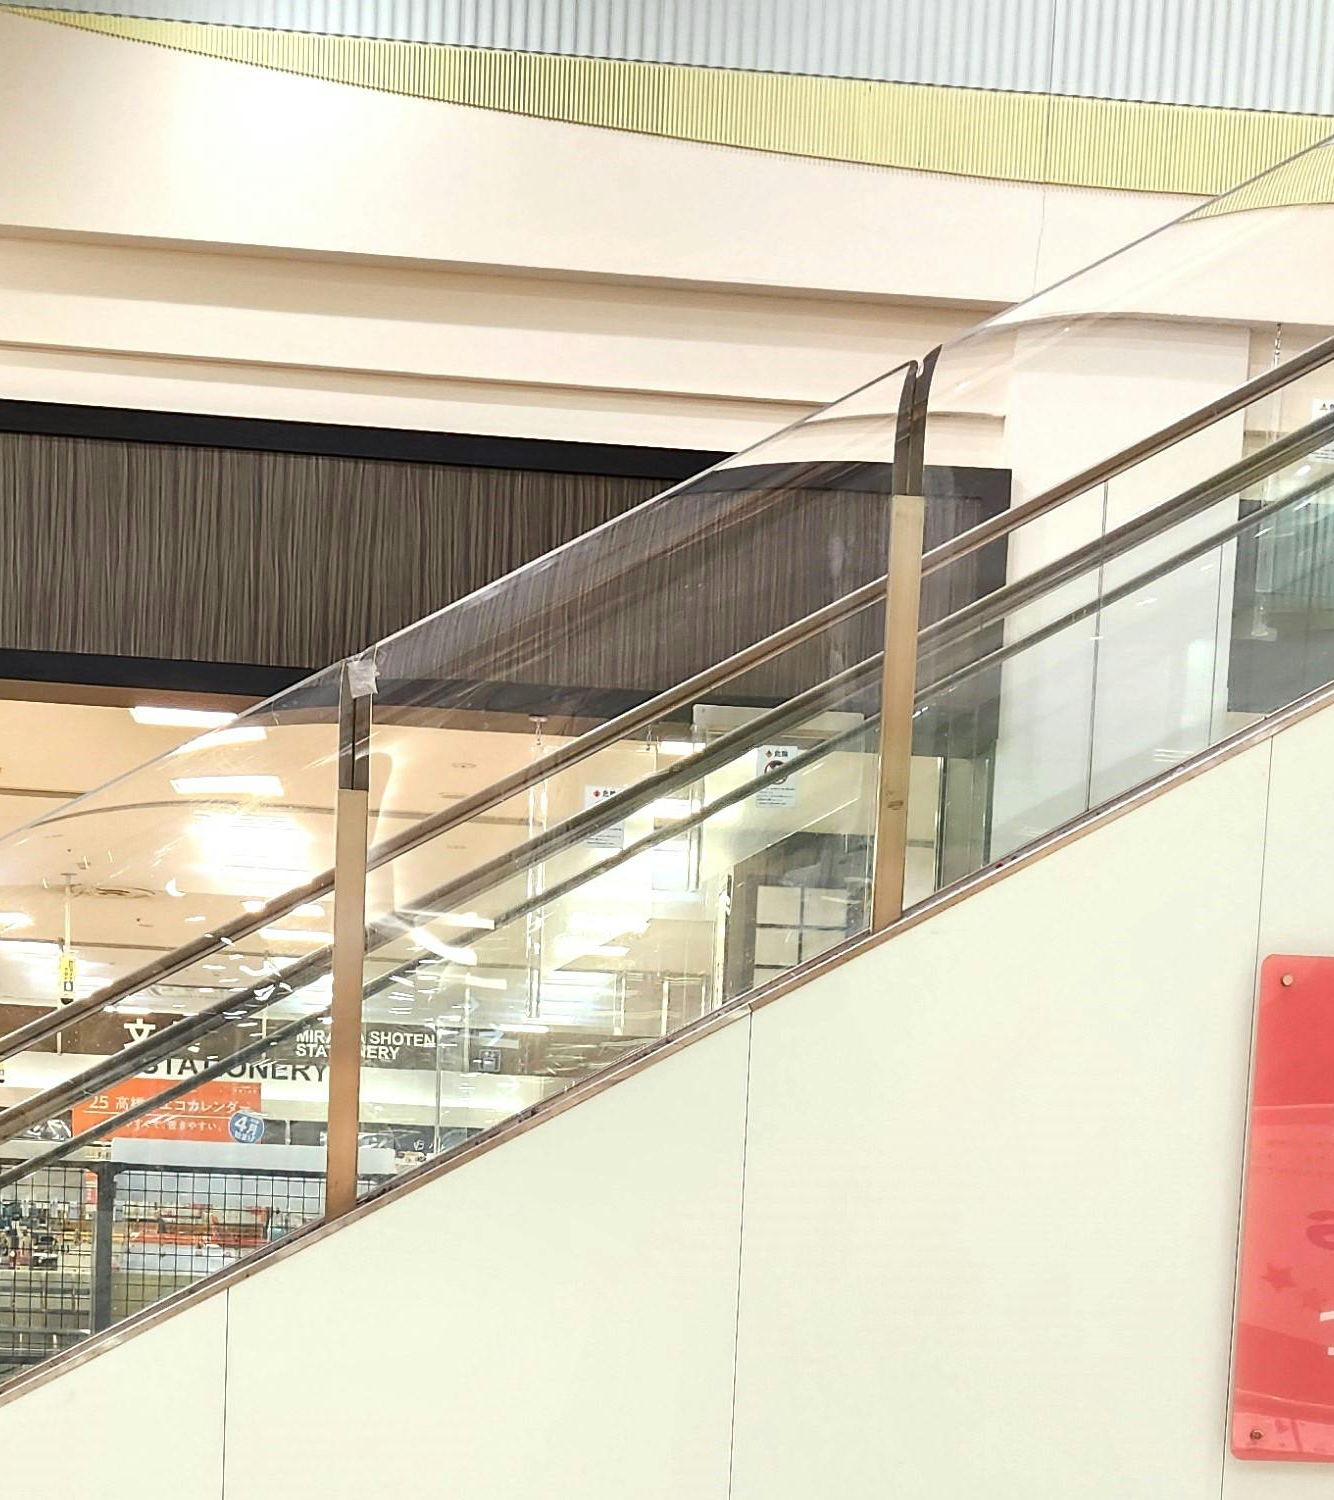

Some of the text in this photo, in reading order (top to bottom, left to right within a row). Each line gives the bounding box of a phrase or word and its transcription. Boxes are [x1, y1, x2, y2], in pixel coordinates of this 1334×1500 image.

[370, 1032, 436, 1048] SHOTEN
[296, 1043, 400, 1060] STAERY
[115, 1096, 252, 1113] 高橋エコカレンダー
